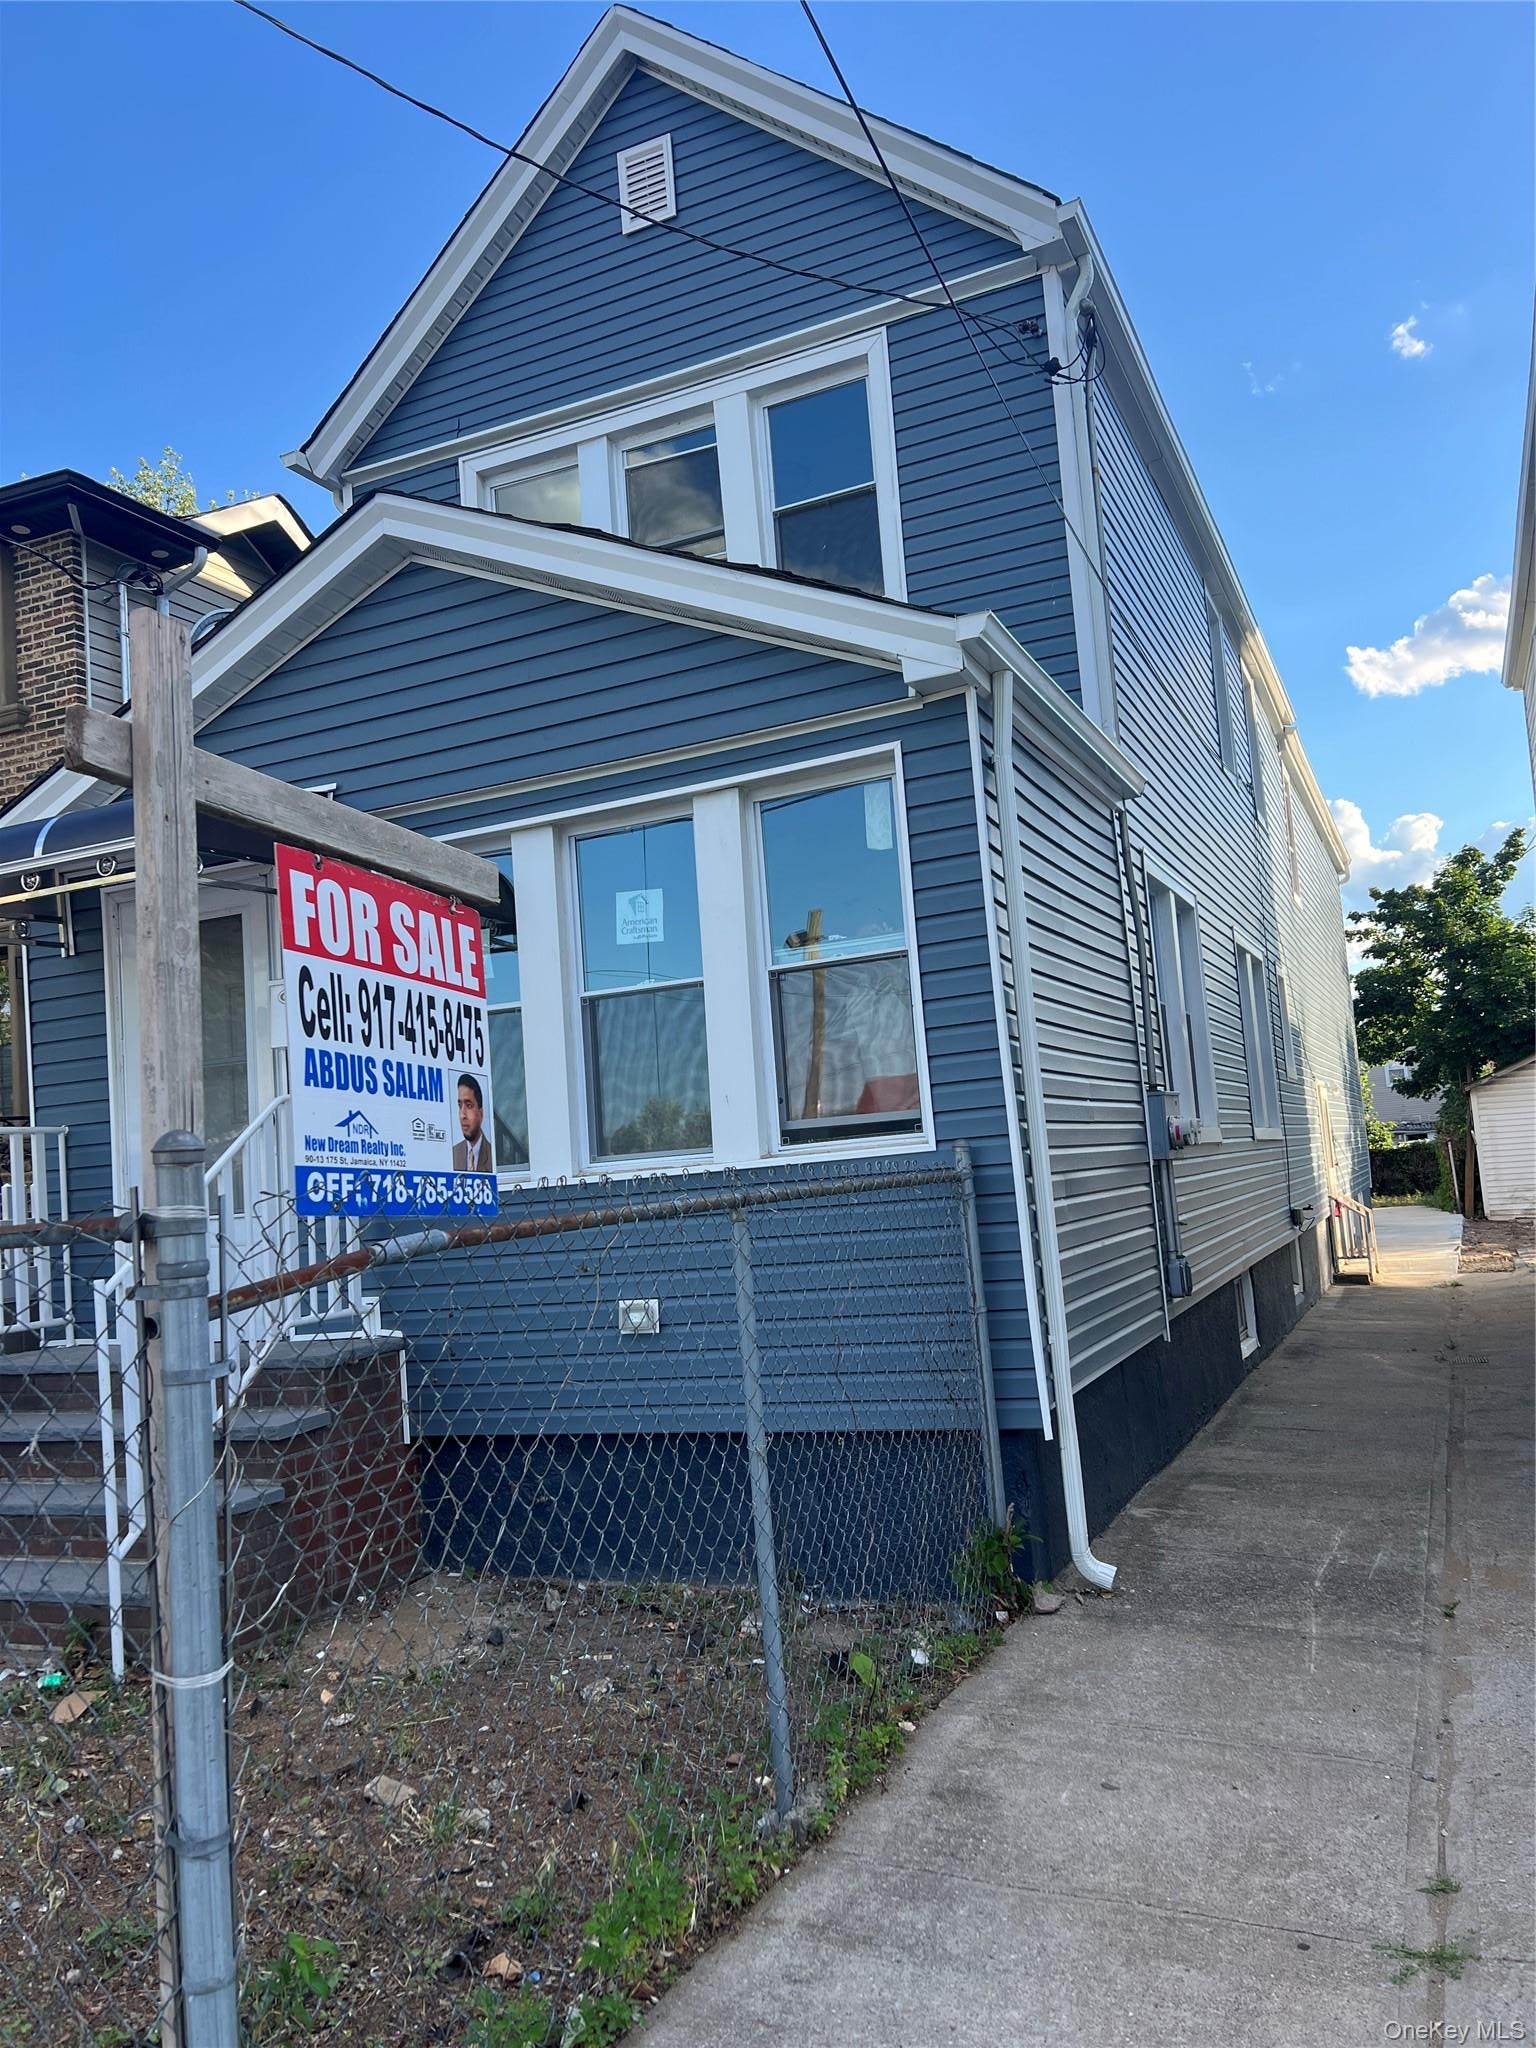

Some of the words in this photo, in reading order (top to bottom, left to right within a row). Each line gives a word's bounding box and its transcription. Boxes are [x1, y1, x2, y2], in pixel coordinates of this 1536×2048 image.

[289, 868, 382, 966] FOR
[389, 900, 480, 992] SALE
[621, 918, 658, 927] American
[621, 926, 658, 936] Craftsman
[299, 965, 353, 1044] Cell:
[359, 978, 485, 1068] 917-415-8475
[304, 1047, 378, 1096] ABDUS
[383, 1061, 444, 1103] SALAM
[305, 1135, 326, 1152] New
[328, 1136, 359, 1154] Dream
[361, 1139, 389, 1157] Realty
[390, 1141, 406, 1157] Inc.
[305, 1155, 324, 1163] 90-13
[326, 1156, 338, 1164] 175
[379, 1159, 388, 1167] NY
[307, 1171, 362, 1203] OFF:
